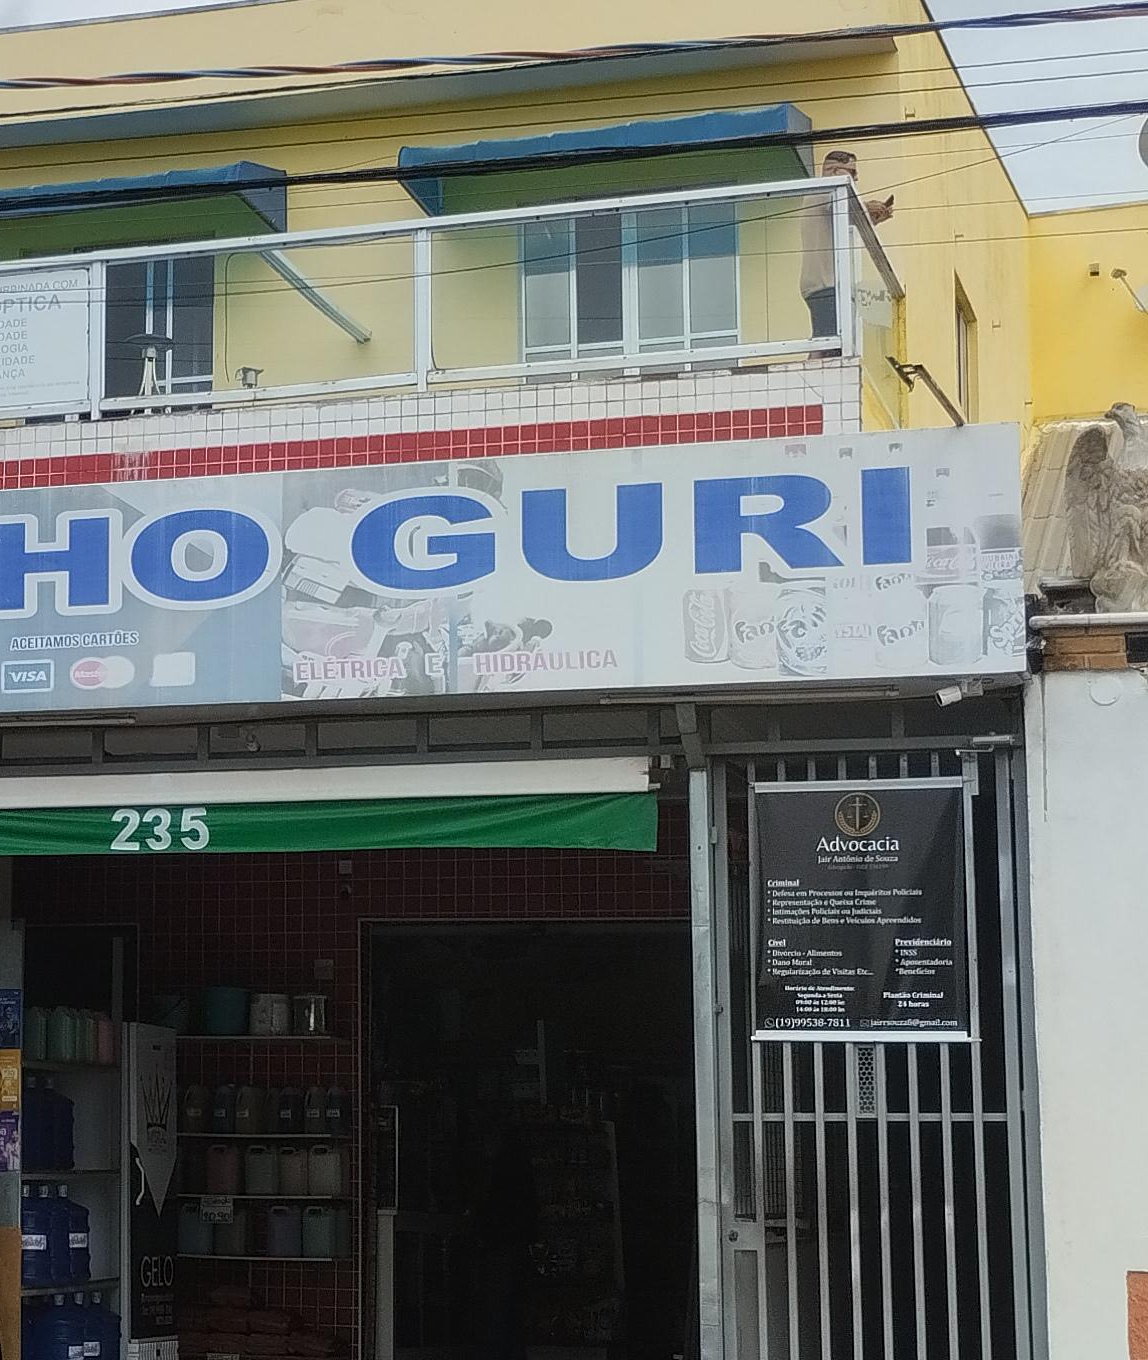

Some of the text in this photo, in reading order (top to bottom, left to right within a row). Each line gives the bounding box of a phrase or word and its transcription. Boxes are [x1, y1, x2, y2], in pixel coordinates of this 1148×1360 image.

[53, 279, 78, 289] COM
[352, 466, 913, 590] GURI
[10, 630, 139, 650] ACEITAMOS CARTÕES
[295, 648, 619, 681] ELÉTRICA E HIDRÁULICA
[8, 670, 47, 683] VISA
[110, 806, 210, 851] 235
[816, 836, 899, 852] Advocacia
[818, 855, 831, 864] Jair
[875, 854, 898, 862] Souza
[767, 879, 799, 888] Criminal
[808, 889, 843, 897] Processos
[893, 888, 922, 896] Policiais
[772, 899, 822, 907] Representação
[772, 908, 810, 916] Intimações
[772, 917, 811, 925] Restituição
[812, 916, 821, 924] de
[876, 916, 921, 925] Apreendidos
[894, 938, 952, 947] Previdenciário
[792, 958, 812, 966] Moral
[900, 958, 952, 967] Aposentadoria
[883, 991, 944, 999] Plantão Criminal
[908, 1000, 930, 1008] horas
[775, 1017, 851, 1029] (19)99538-7811
[140, 1255, 175, 1288] GELO
